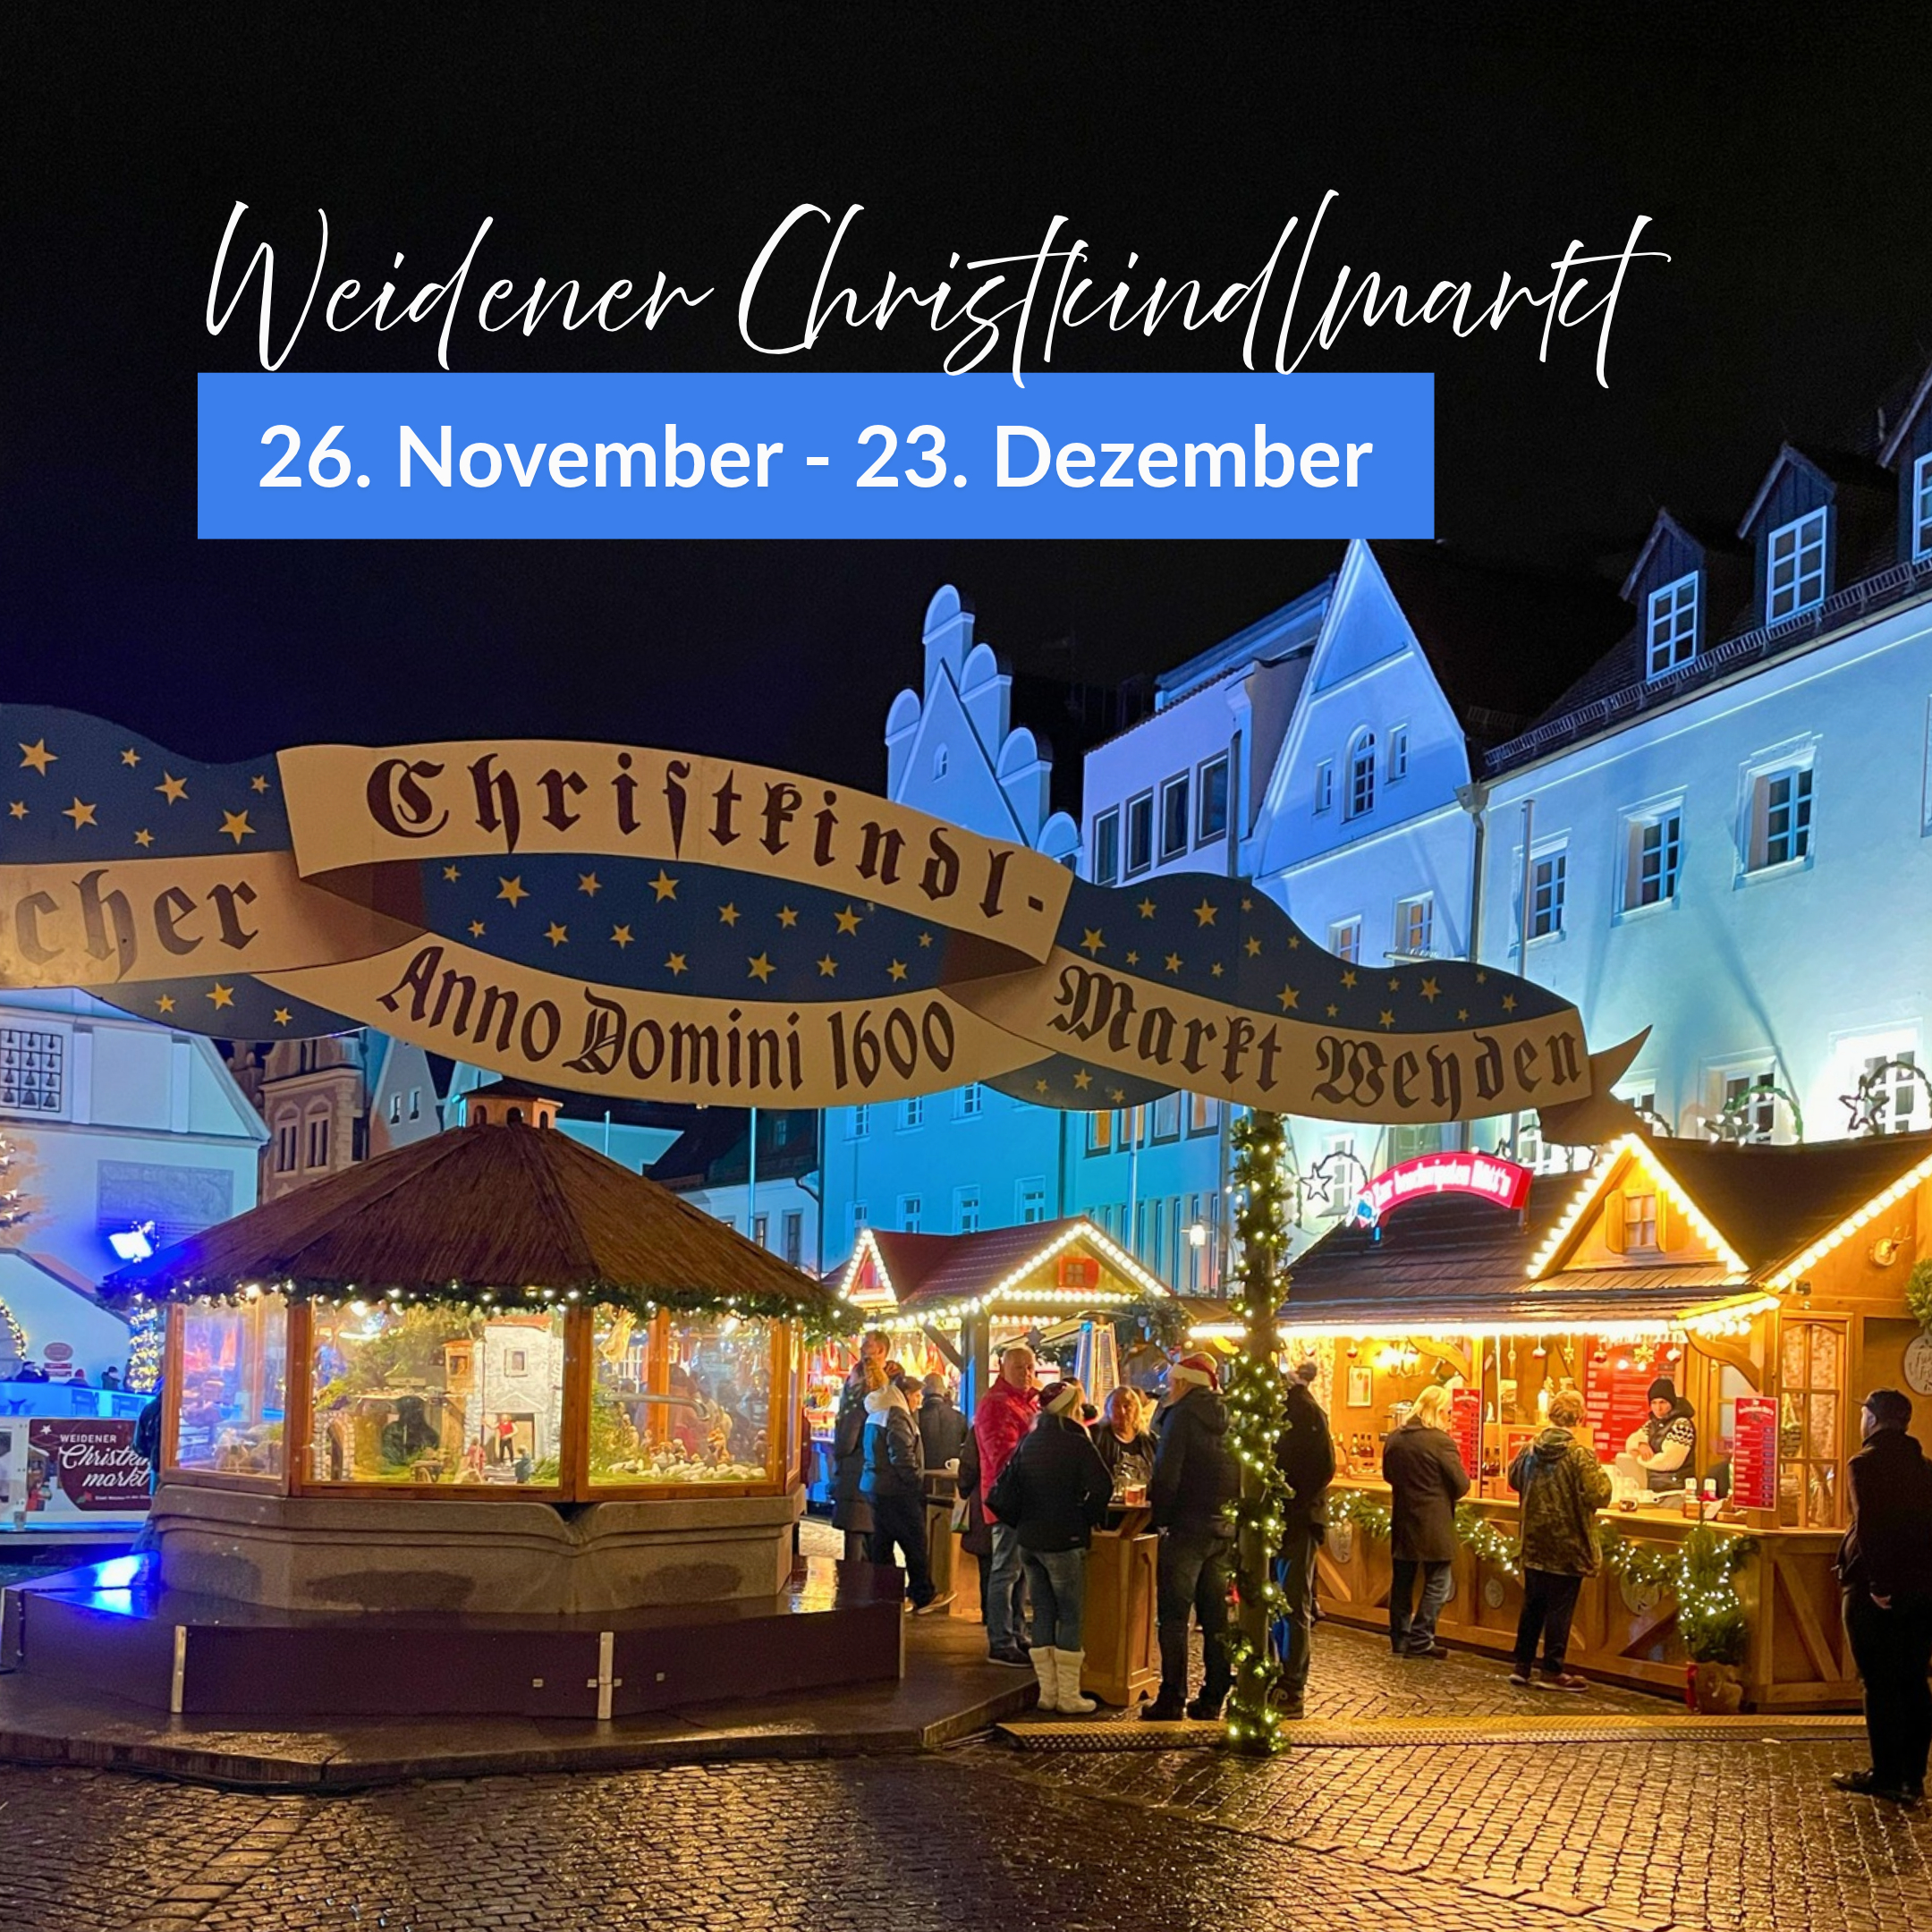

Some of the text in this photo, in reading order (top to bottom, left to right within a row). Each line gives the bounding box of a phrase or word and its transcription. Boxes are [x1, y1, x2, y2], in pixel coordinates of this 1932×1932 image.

[376, 945, 956, 1092] Anno Domini 1600
[1046, 964, 1284, 1094] Markt
[60, 1434, 117, 1444] WEIDENER
[82, 1466, 150, 1487] markt
